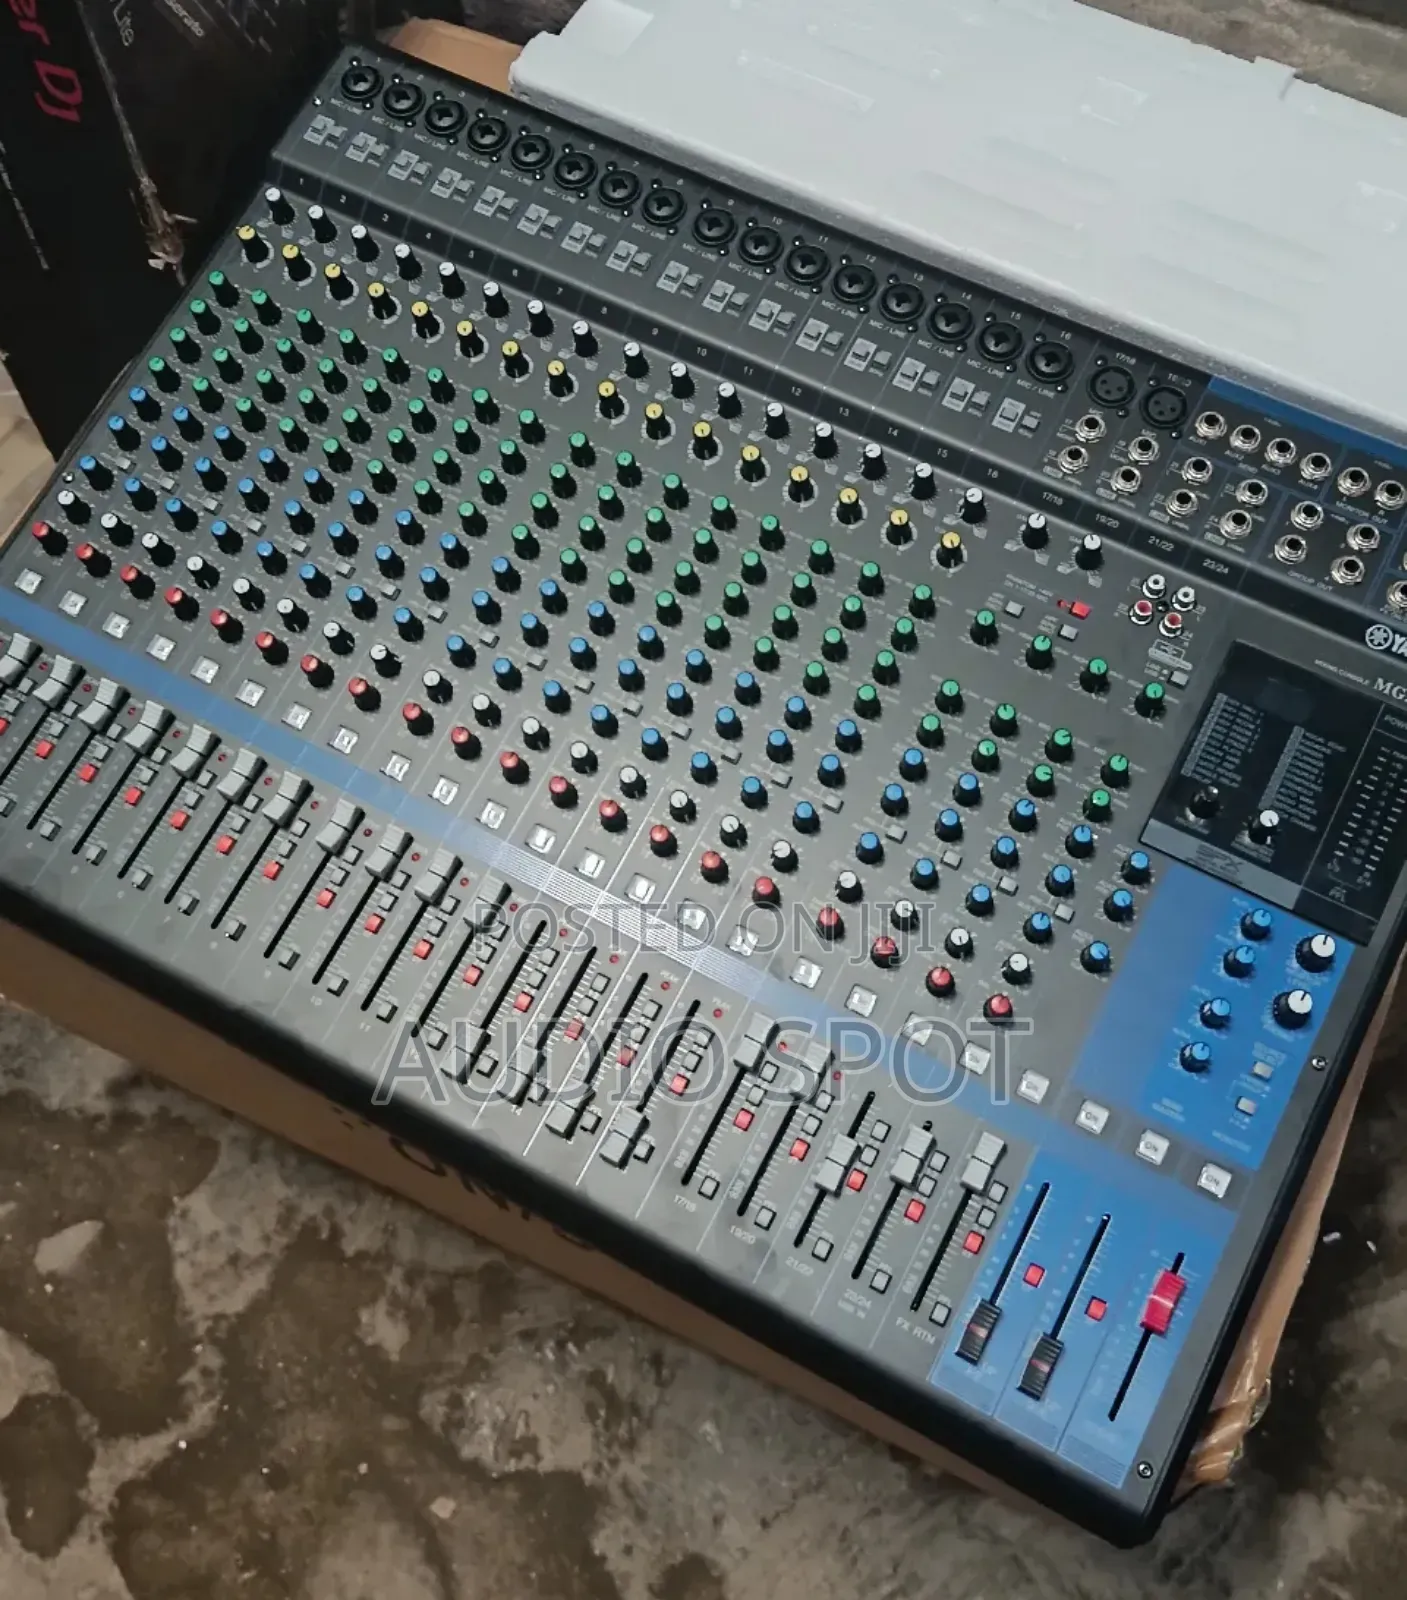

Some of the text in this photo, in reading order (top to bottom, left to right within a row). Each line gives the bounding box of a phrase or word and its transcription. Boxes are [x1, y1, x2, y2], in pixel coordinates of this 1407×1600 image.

[34, 60, 83, 122] DJ
[682, 243, 696, 252] MIC
[701, 252, 718, 262] LINE
[728, 262, 742, 272] MIC
[748, 270, 764, 280] LINE
[774, 281, 788, 290] MIC
[794, 290, 810, 300] LINE
[822, 300, 836, 310] MIC
[842, 310, 858, 319] LINE
[868, 320, 884, 329] MIC
[889, 328, 906, 338] LINE
[697, 347, 707, 356] 10
[917, 340, 932, 349] MIC
[938, 348, 955, 358] LINE
[744, 366, 754, 376] 11
[966, 359, 982, 368] MIC
[987, 368, 1005, 378] LINE
[791, 386, 802, 396] 12
[1017, 380, 1031, 390] MIC
[1038, 388, 1056, 398] LINE
[839, 407, 850, 416] 13
[888, 427, 898, 436] 14
[937, 448, 948, 458] 15
[987, 468, 998, 478] 16
[1042, 491, 1063, 506] 17/18
[1096, 514, 1119, 528] 19/20
[1336, 500, 1388, 525] MONITOR OUT
[1148, 536, 1174, 551] 21/22
[1202, 558, 1229, 574] 23/24
[1373, 677, 1407, 703] MG
[730, 1225, 756, 1245] 19/20
[895, 1316, 937, 1345] FX RTN
